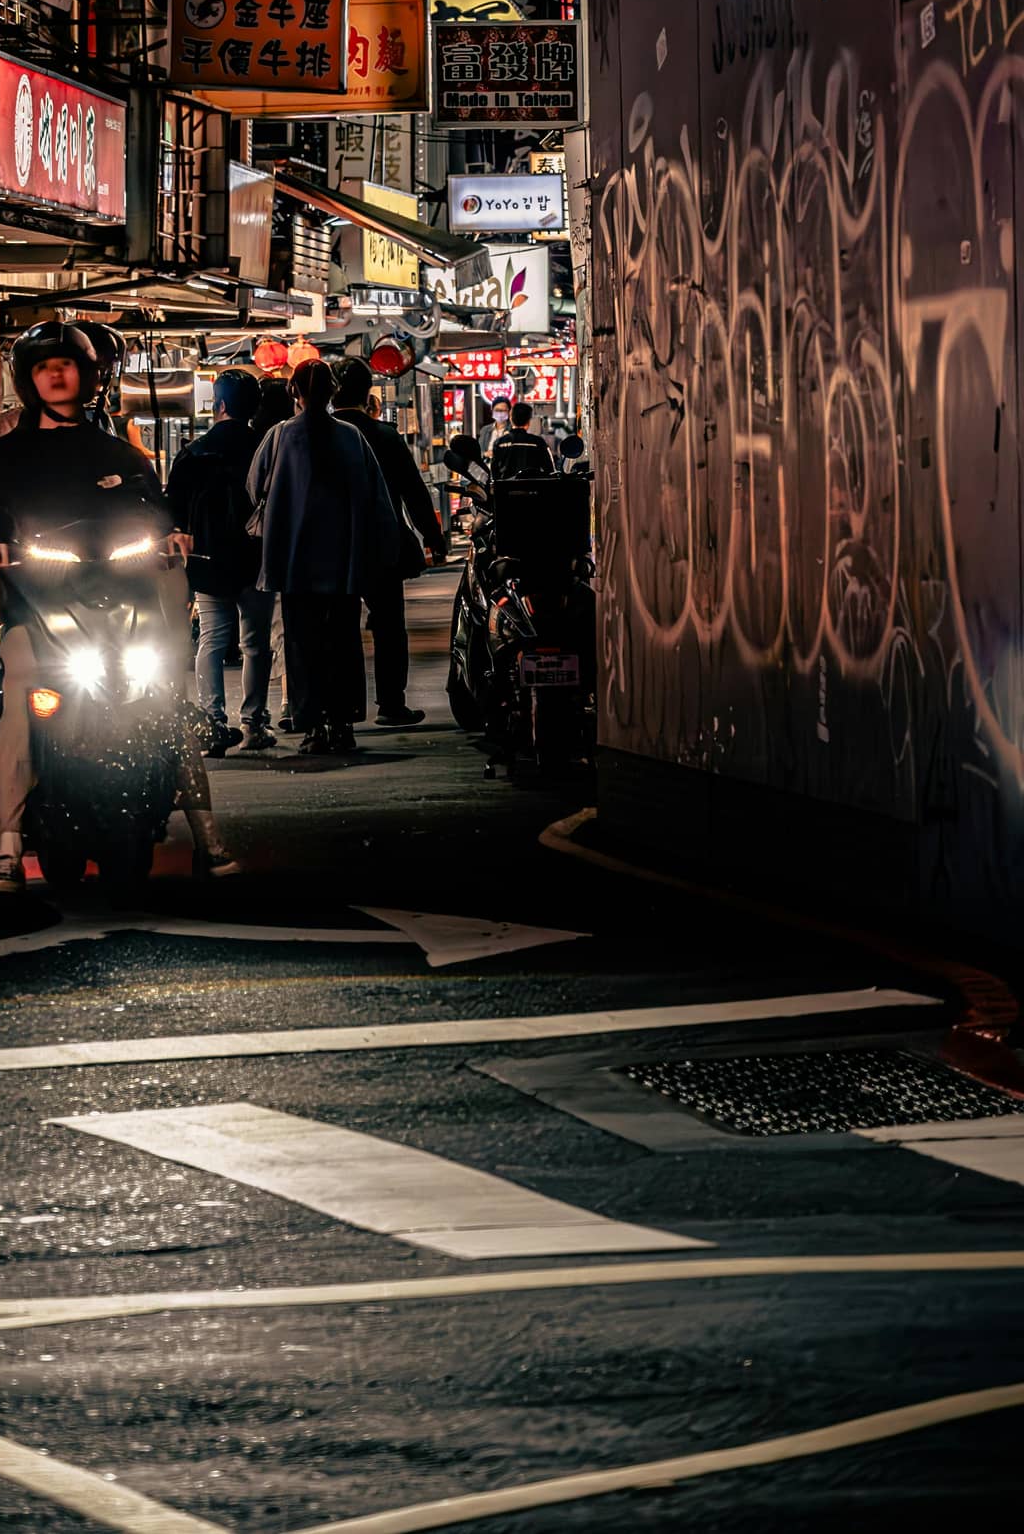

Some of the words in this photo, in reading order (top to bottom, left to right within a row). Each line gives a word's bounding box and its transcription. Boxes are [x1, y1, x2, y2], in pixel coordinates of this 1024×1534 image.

[180, 36, 332, 78] 平價牛排
[442, 41, 574, 82] 富發牌
[446, 93, 488, 107] Made
[516, 92, 571, 107] Taiwan
[485, 198, 519, 211] YoYo
[522, 195, 551, 212] 김밥
